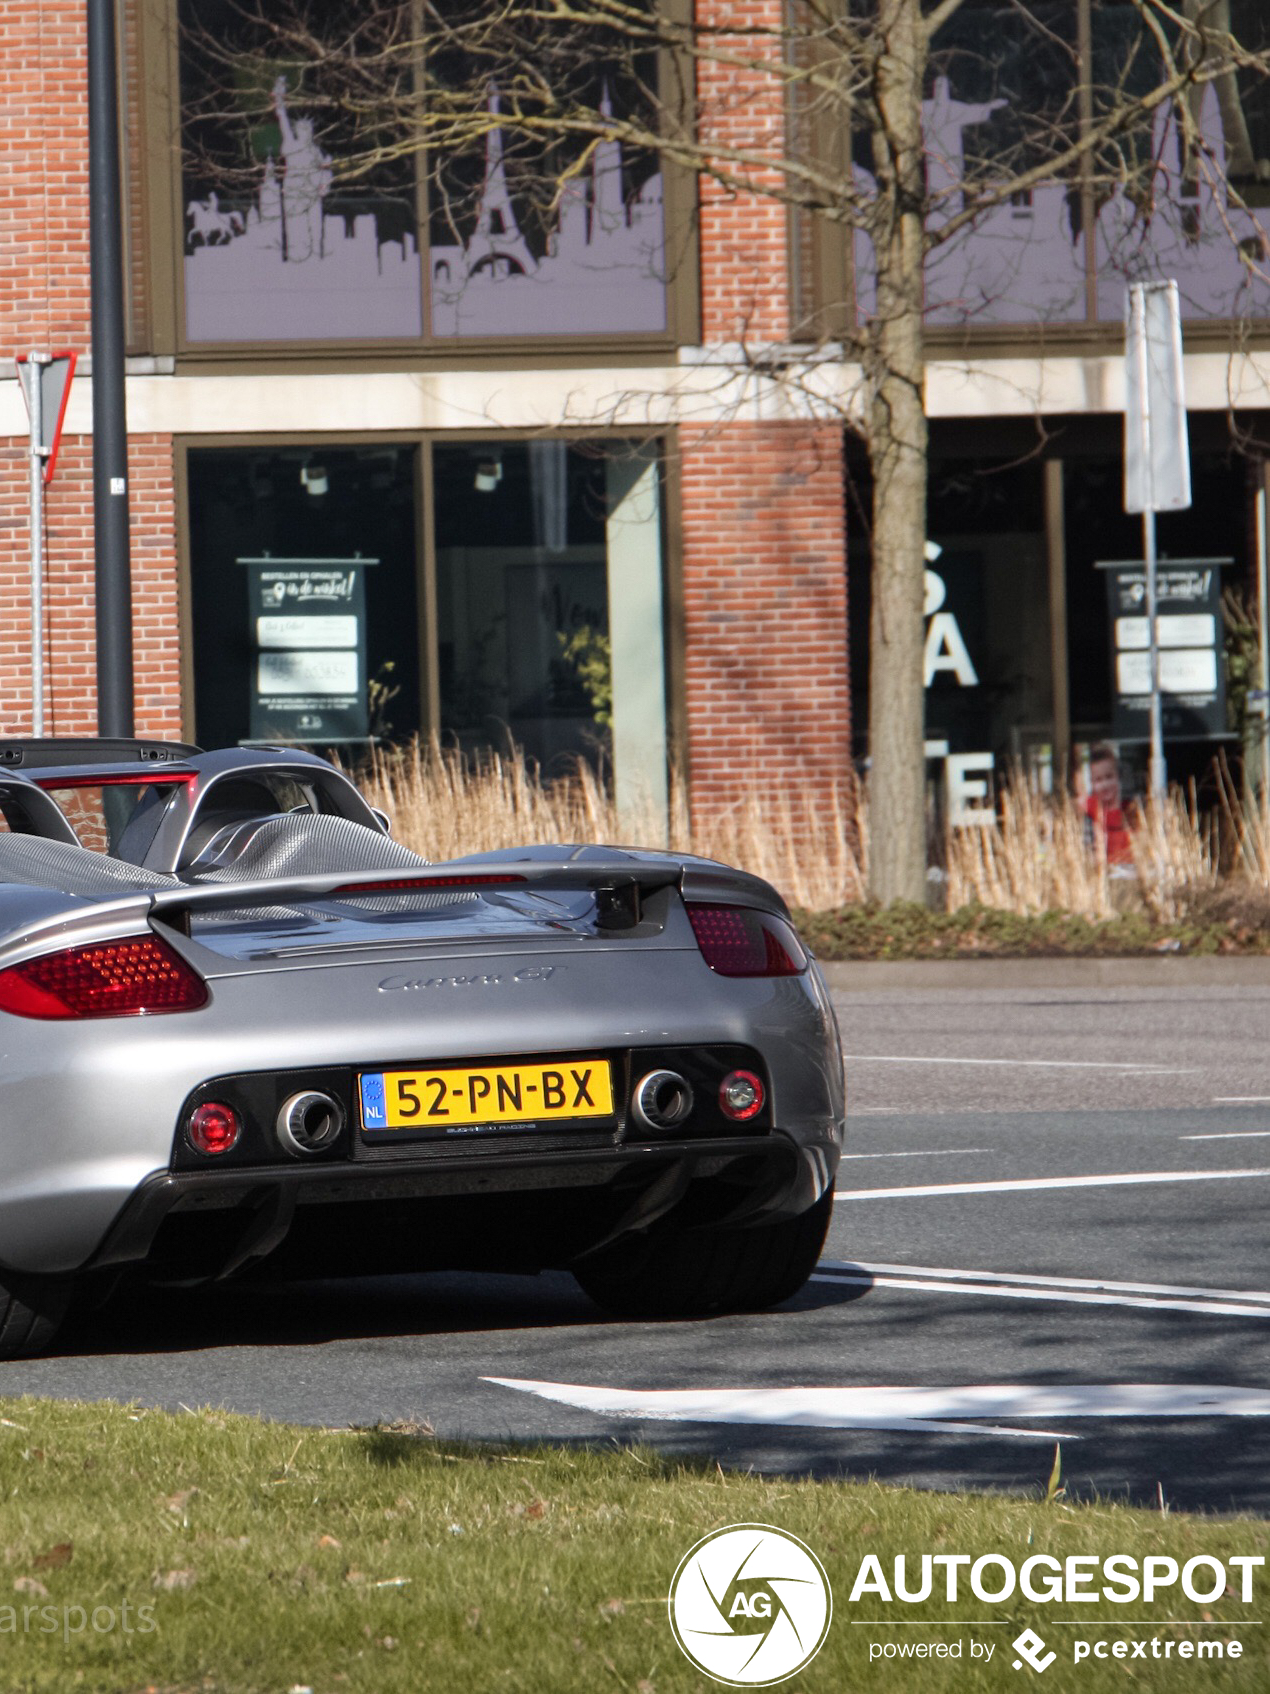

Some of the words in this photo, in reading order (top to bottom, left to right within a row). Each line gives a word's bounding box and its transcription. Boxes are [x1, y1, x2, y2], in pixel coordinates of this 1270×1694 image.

[377, 974, 505, 993] Carrera
[514, 965, 568, 982] GT
[397, 1069, 595, 1118] 52-PN-BX
[366, 1105, 383, 1119] NL
